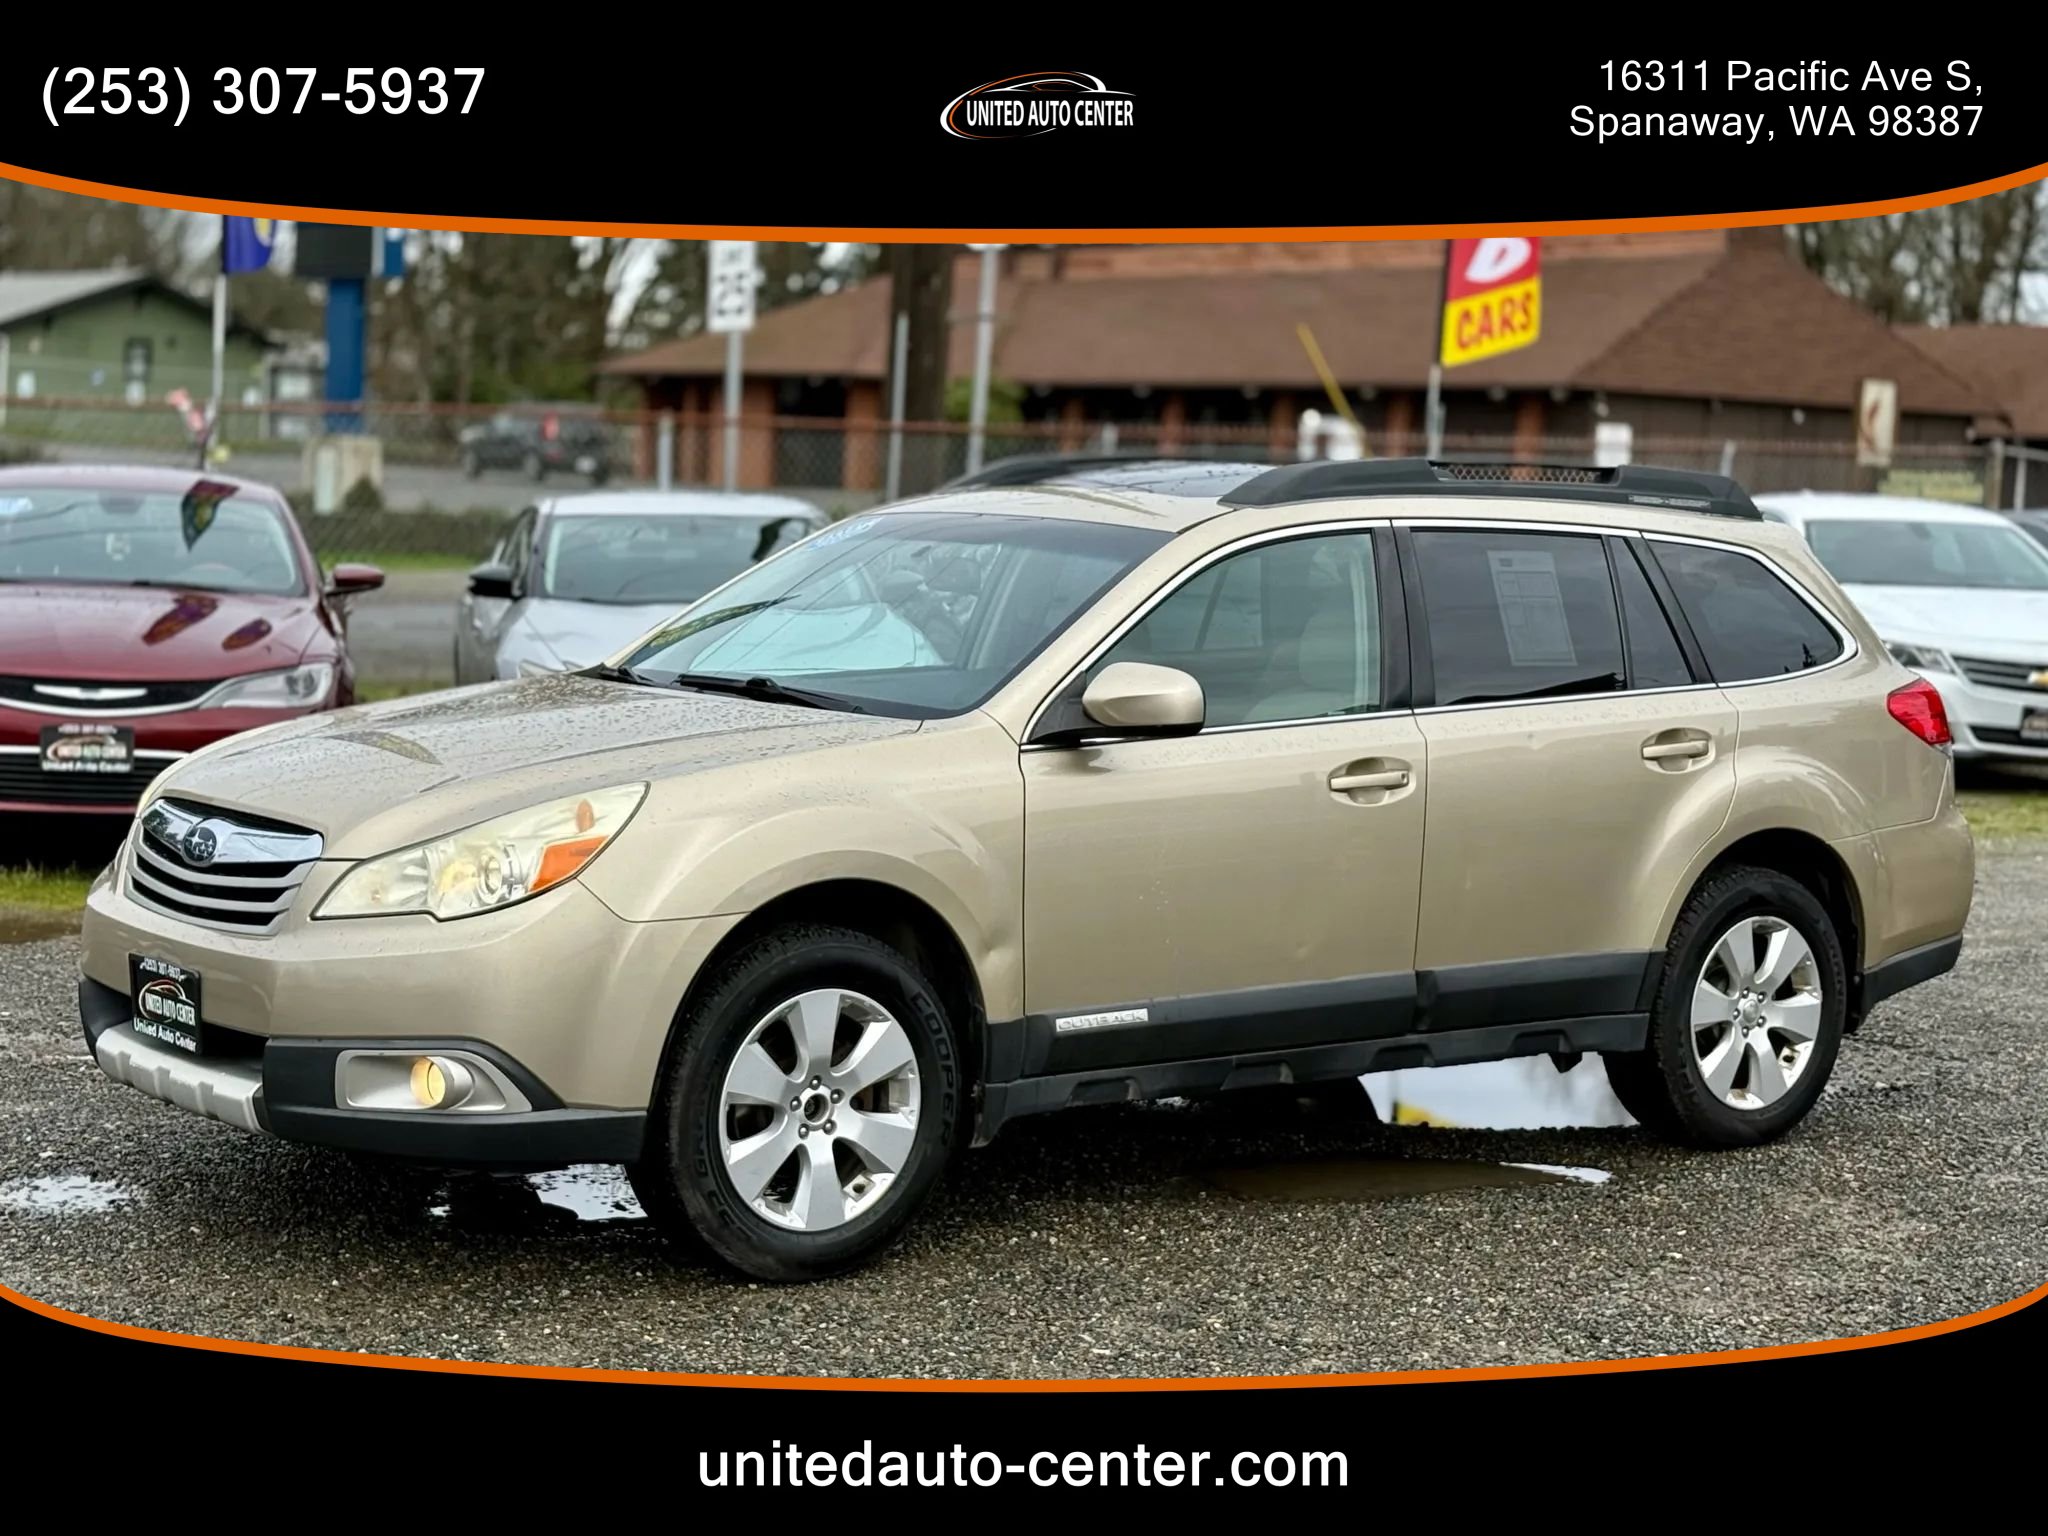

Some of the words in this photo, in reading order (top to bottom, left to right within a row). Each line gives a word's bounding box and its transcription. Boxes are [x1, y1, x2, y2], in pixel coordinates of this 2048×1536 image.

[1456, 292, 1532, 351] CARS
[144, 992, 163, 1015] UNITED
[162, 998, 176, 1020] AUTO
[176, 1003, 196, 1027] CENTER
[1057, 1010, 1147, 1031] OUTBACK
[133, 1016, 157, 1038] United
[158, 1025, 175, 1045] Auto
[175, 1031, 197, 1053] Center
[910, 991, 955, 1147] COOPER
